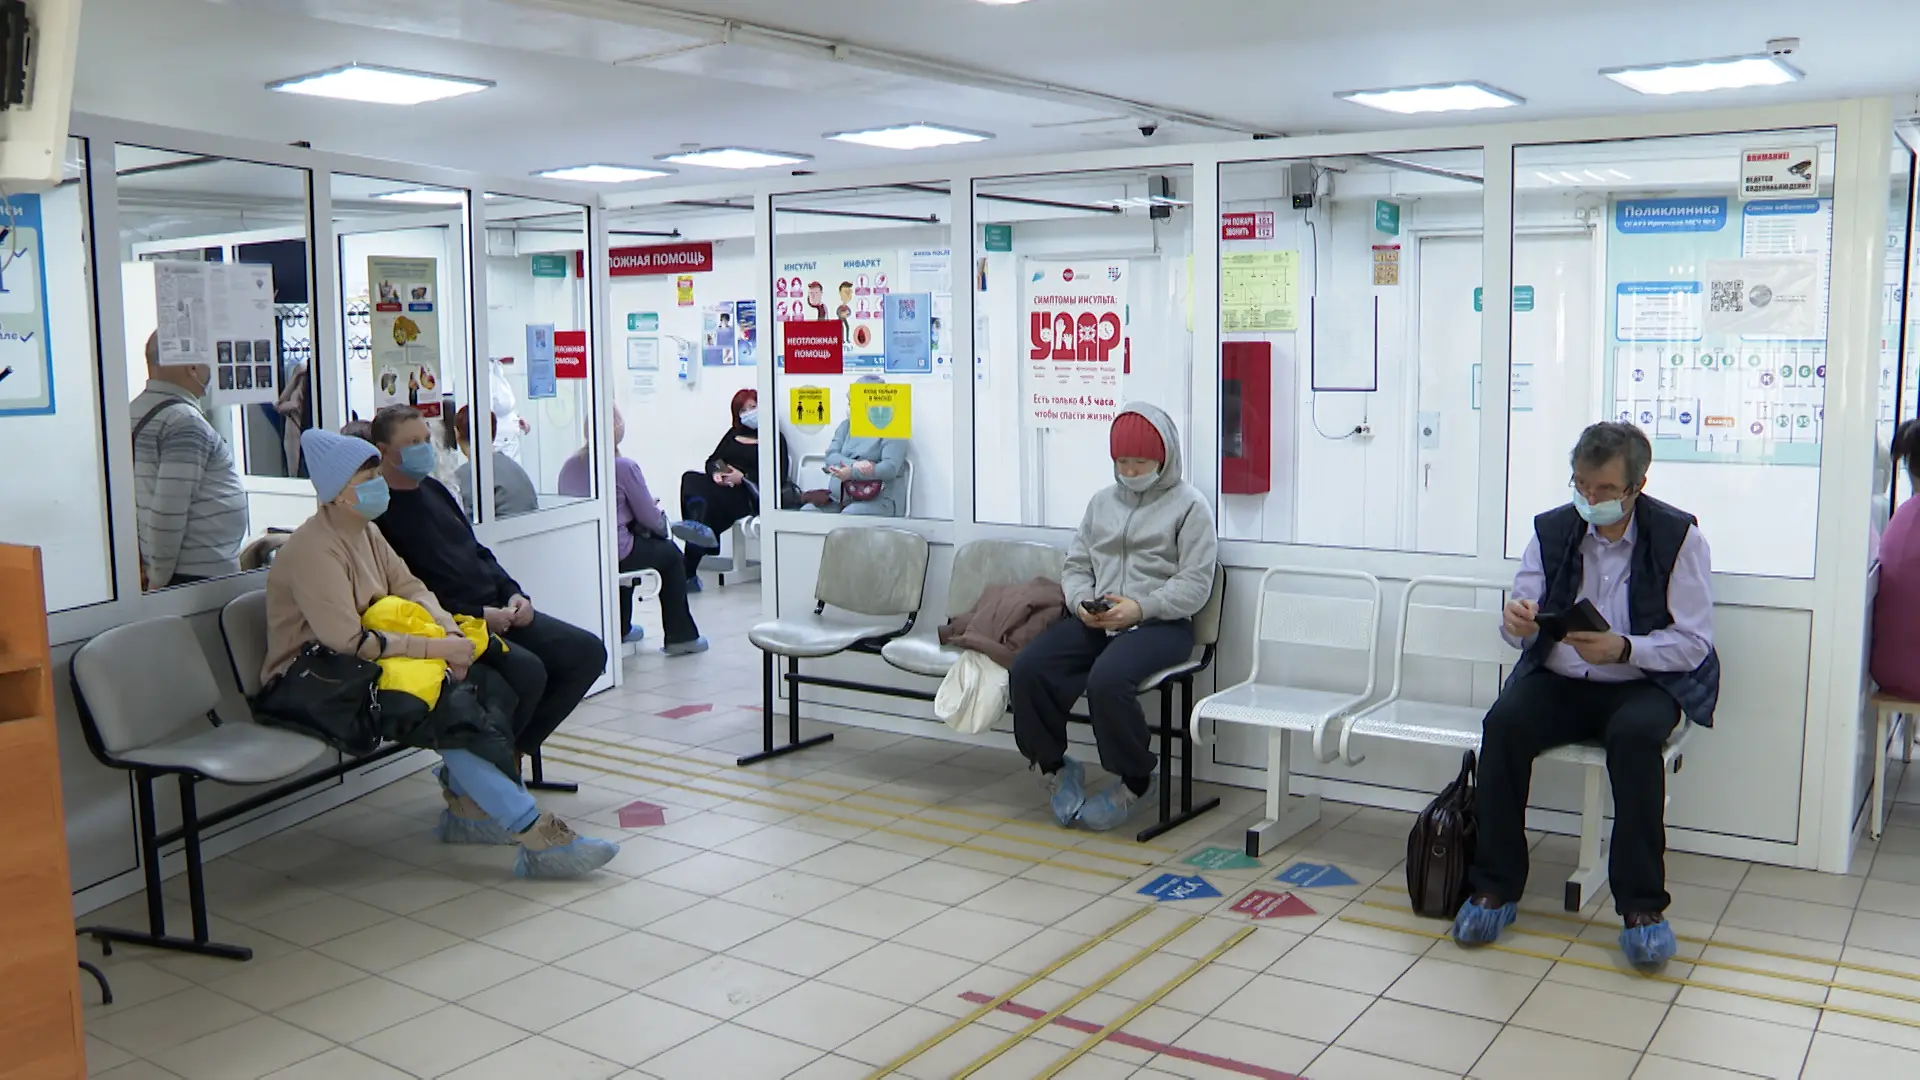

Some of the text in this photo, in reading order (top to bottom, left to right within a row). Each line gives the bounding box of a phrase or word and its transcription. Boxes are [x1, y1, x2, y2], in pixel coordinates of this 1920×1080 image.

[1624, 205, 1720, 217] Поликлиника
[652, 251, 705, 266] ПОМОЩЬ
[843, 259, 882, 269] ИНФАРКТ
[1033, 295, 1118, 306] СИМПТОМЫ ИНСУЛЬТА:
[787, 336, 838, 346] НЕОТЛОЖНАЯ
[1031, 311, 1121, 362] УДАР
[794, 349, 831, 359] ПОМОЩЬ
[1033, 393, 1050, 404] Есть
[1052, 395, 1078, 405] только
[1034, 409, 1059, 419] чтобы
[1059, 411, 1086, 420] спасти
